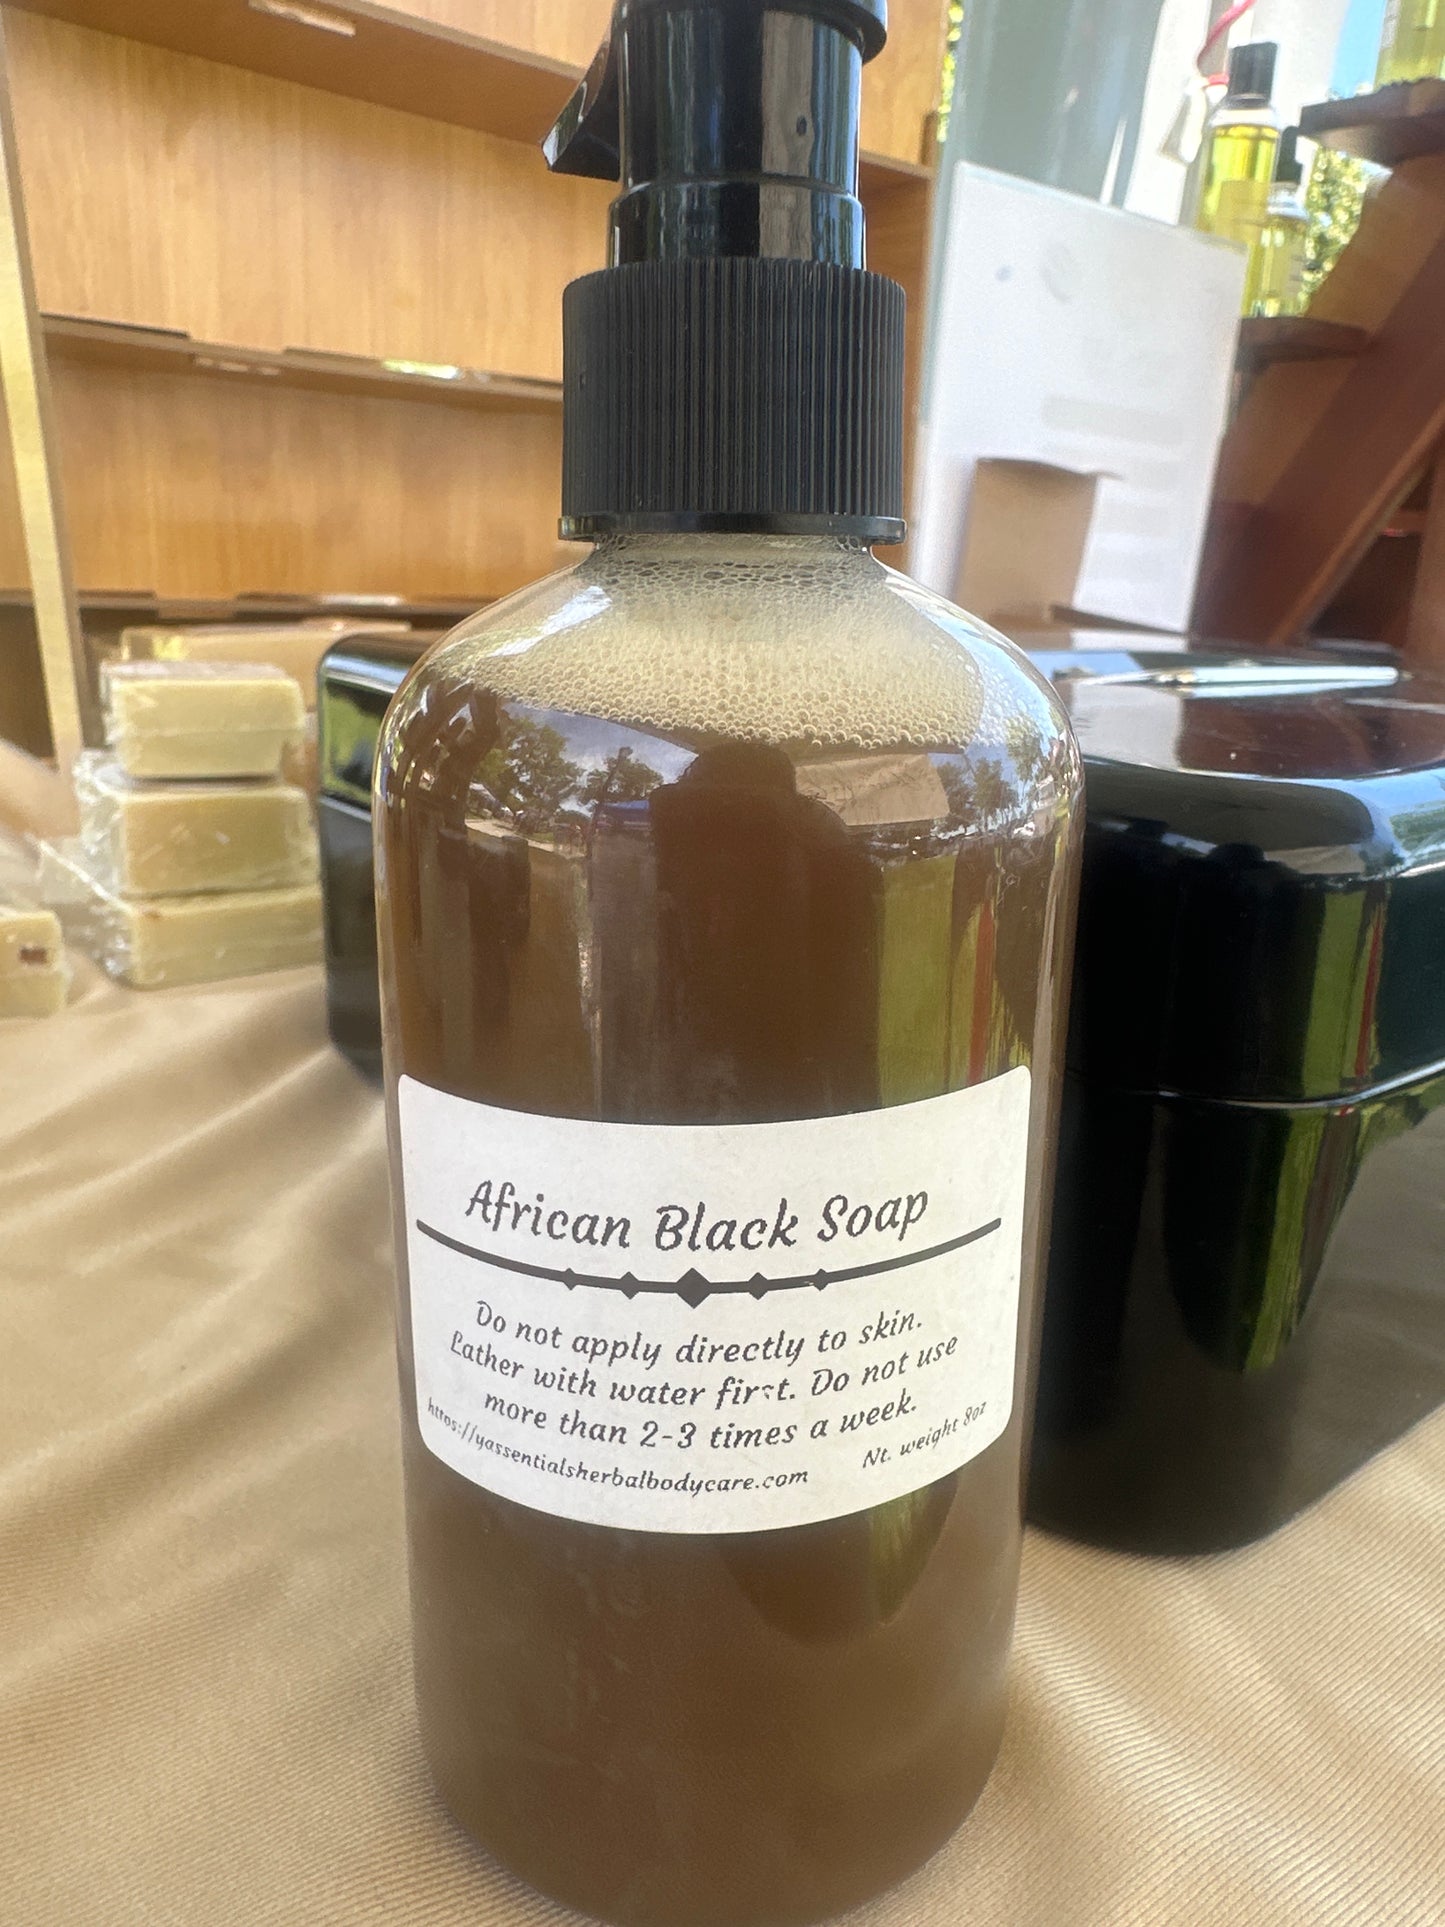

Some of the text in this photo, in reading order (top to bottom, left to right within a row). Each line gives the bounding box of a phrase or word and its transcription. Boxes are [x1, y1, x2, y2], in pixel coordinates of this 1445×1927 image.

[464, 1179, 929, 1253] African Black Soap
[450, 1330, 525, 1379] Lather
[533, 1366, 597, 1398] with
[608, 1381, 706, 1406] water
[811, 1368, 850, 1397] Do
[861, 1351, 910, 1386] not
[916, 1336, 959, 1369] use
[476, 1299, 923, 1371] Do not apply directly to skin.
[484, 1387, 917, 1450] more than 2-3 times a week.
[862, 1401, 987, 1469] Nt. weight 8oz
